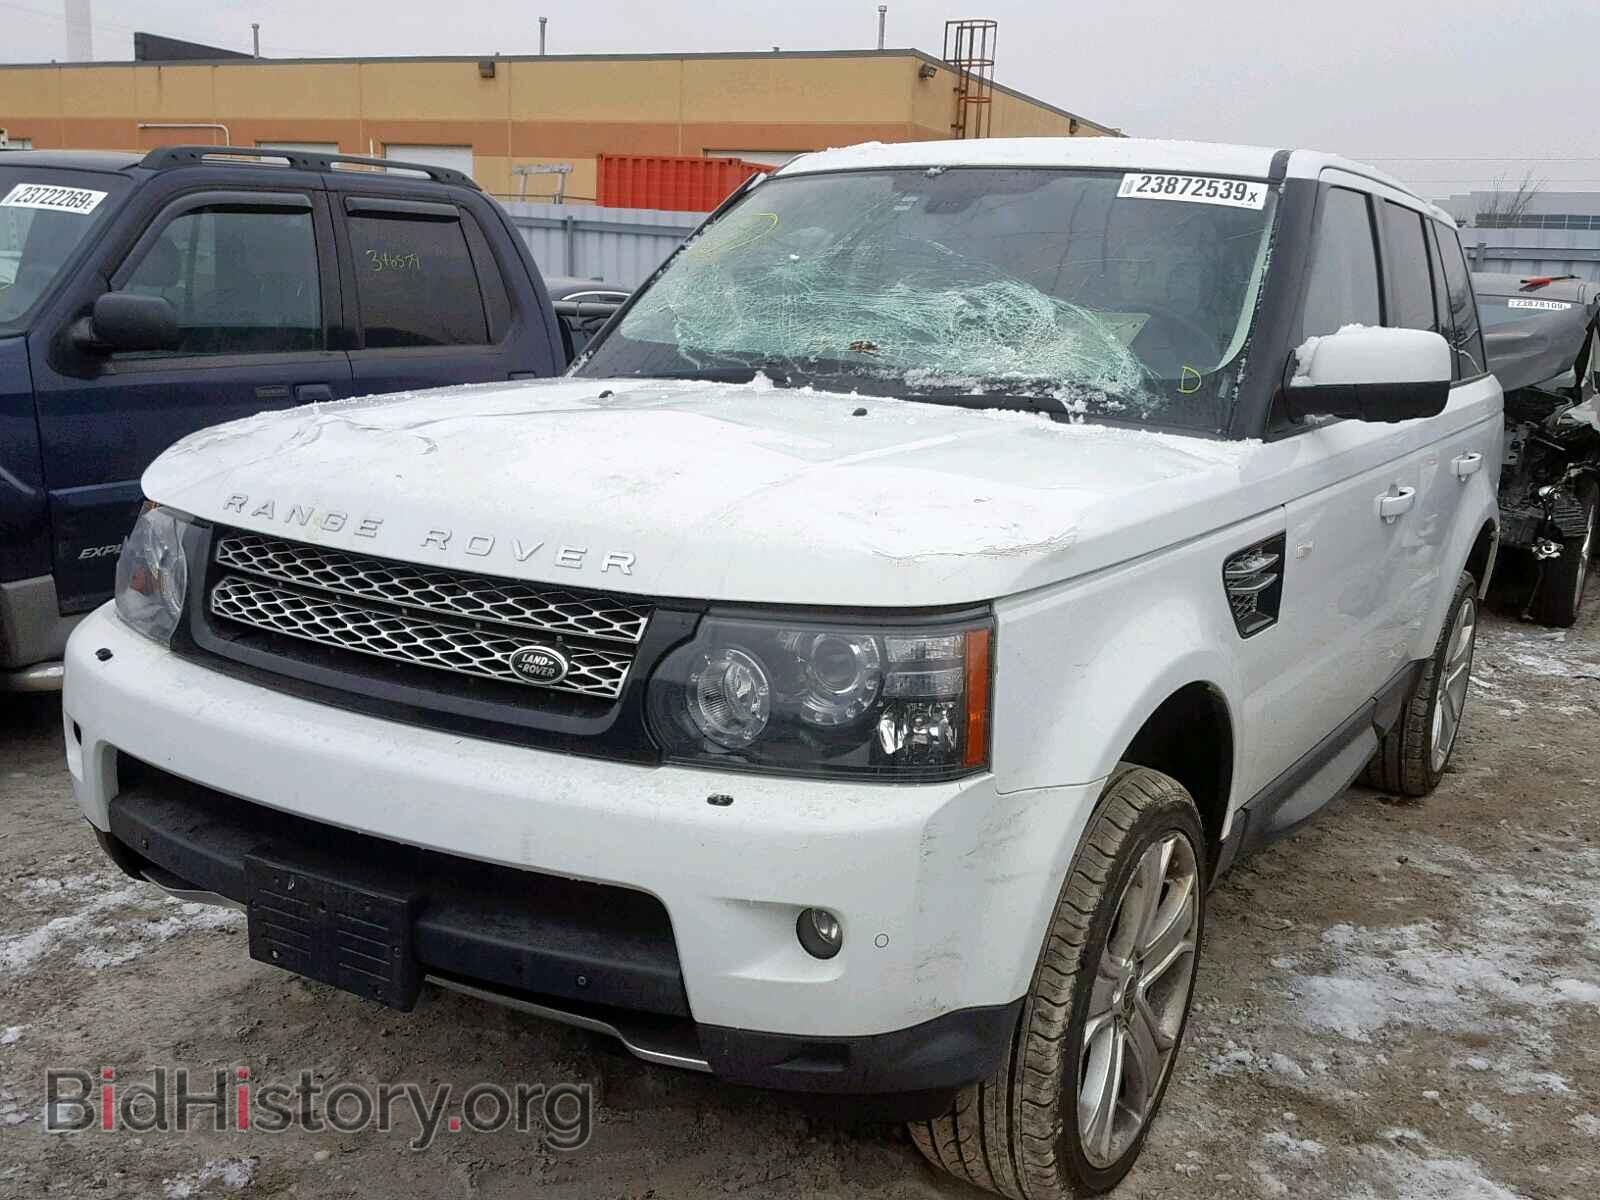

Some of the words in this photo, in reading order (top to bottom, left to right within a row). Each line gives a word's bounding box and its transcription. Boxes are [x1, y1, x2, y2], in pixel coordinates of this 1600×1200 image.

[1176, 366, 1202, 393] D
[222, 492, 384, 538] RANGE
[420, 528, 638, 576] ROVER
[521, 653, 548, 666] LAND
[522, 663, 555, 677] ROVER
